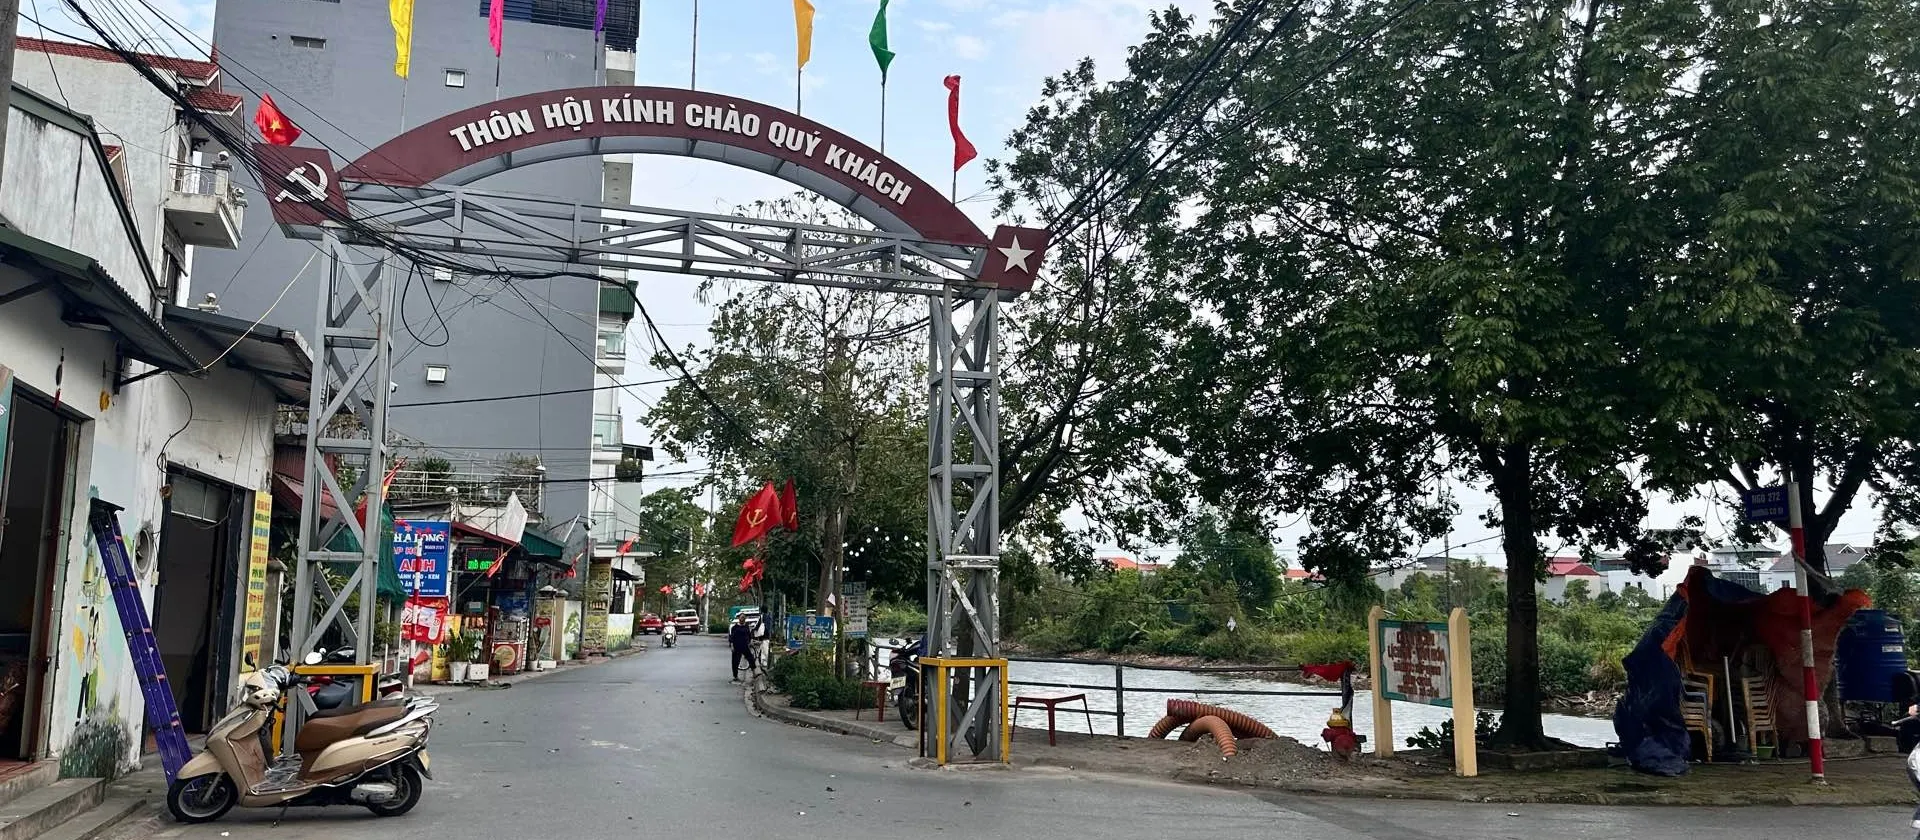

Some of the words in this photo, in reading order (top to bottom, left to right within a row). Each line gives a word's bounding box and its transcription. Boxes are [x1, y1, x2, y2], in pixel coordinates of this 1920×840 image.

[449, 109, 535, 152] THÔN
[542, 97, 594, 131] HỘI
[602, 93, 675, 124] KÍNH
[685, 103, 760, 137] CHÀO
[769, 120, 822, 157] QUÝ
[824, 143, 913, 205] KHÁCH
[1768, 492, 1781, 502] 272
